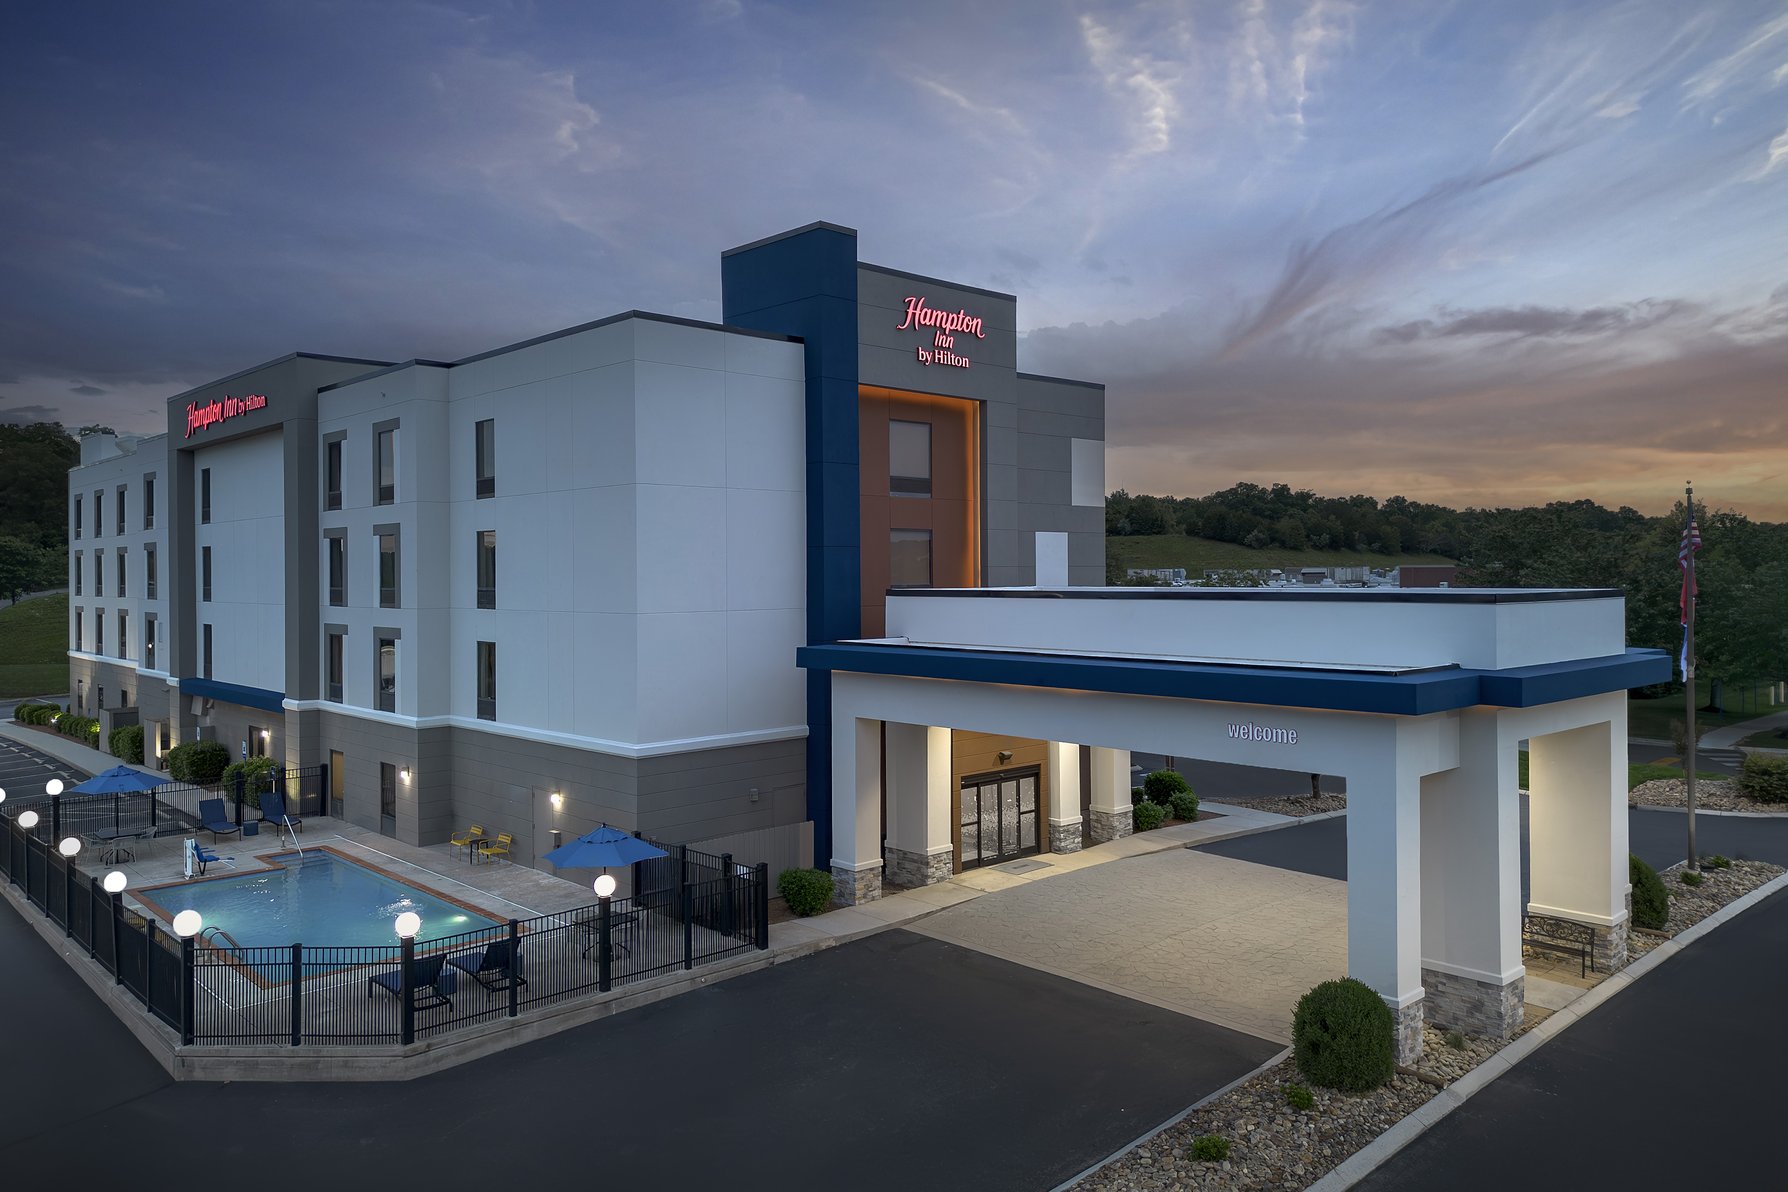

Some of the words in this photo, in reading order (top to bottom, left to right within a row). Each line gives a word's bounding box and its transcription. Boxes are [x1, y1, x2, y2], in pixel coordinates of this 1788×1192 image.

[896, 297, 986, 338] Hampton
[934, 330, 954, 349] Inn
[918, 346, 933, 366] by
[934, 349, 970, 368] Hilton
[184, 400, 224, 439] Hampton
[223, 395, 238, 419] Inn
[238, 398, 246, 416] by
[245, 394, 267, 411] Hilton
[1227, 721, 1298, 744] welcome
